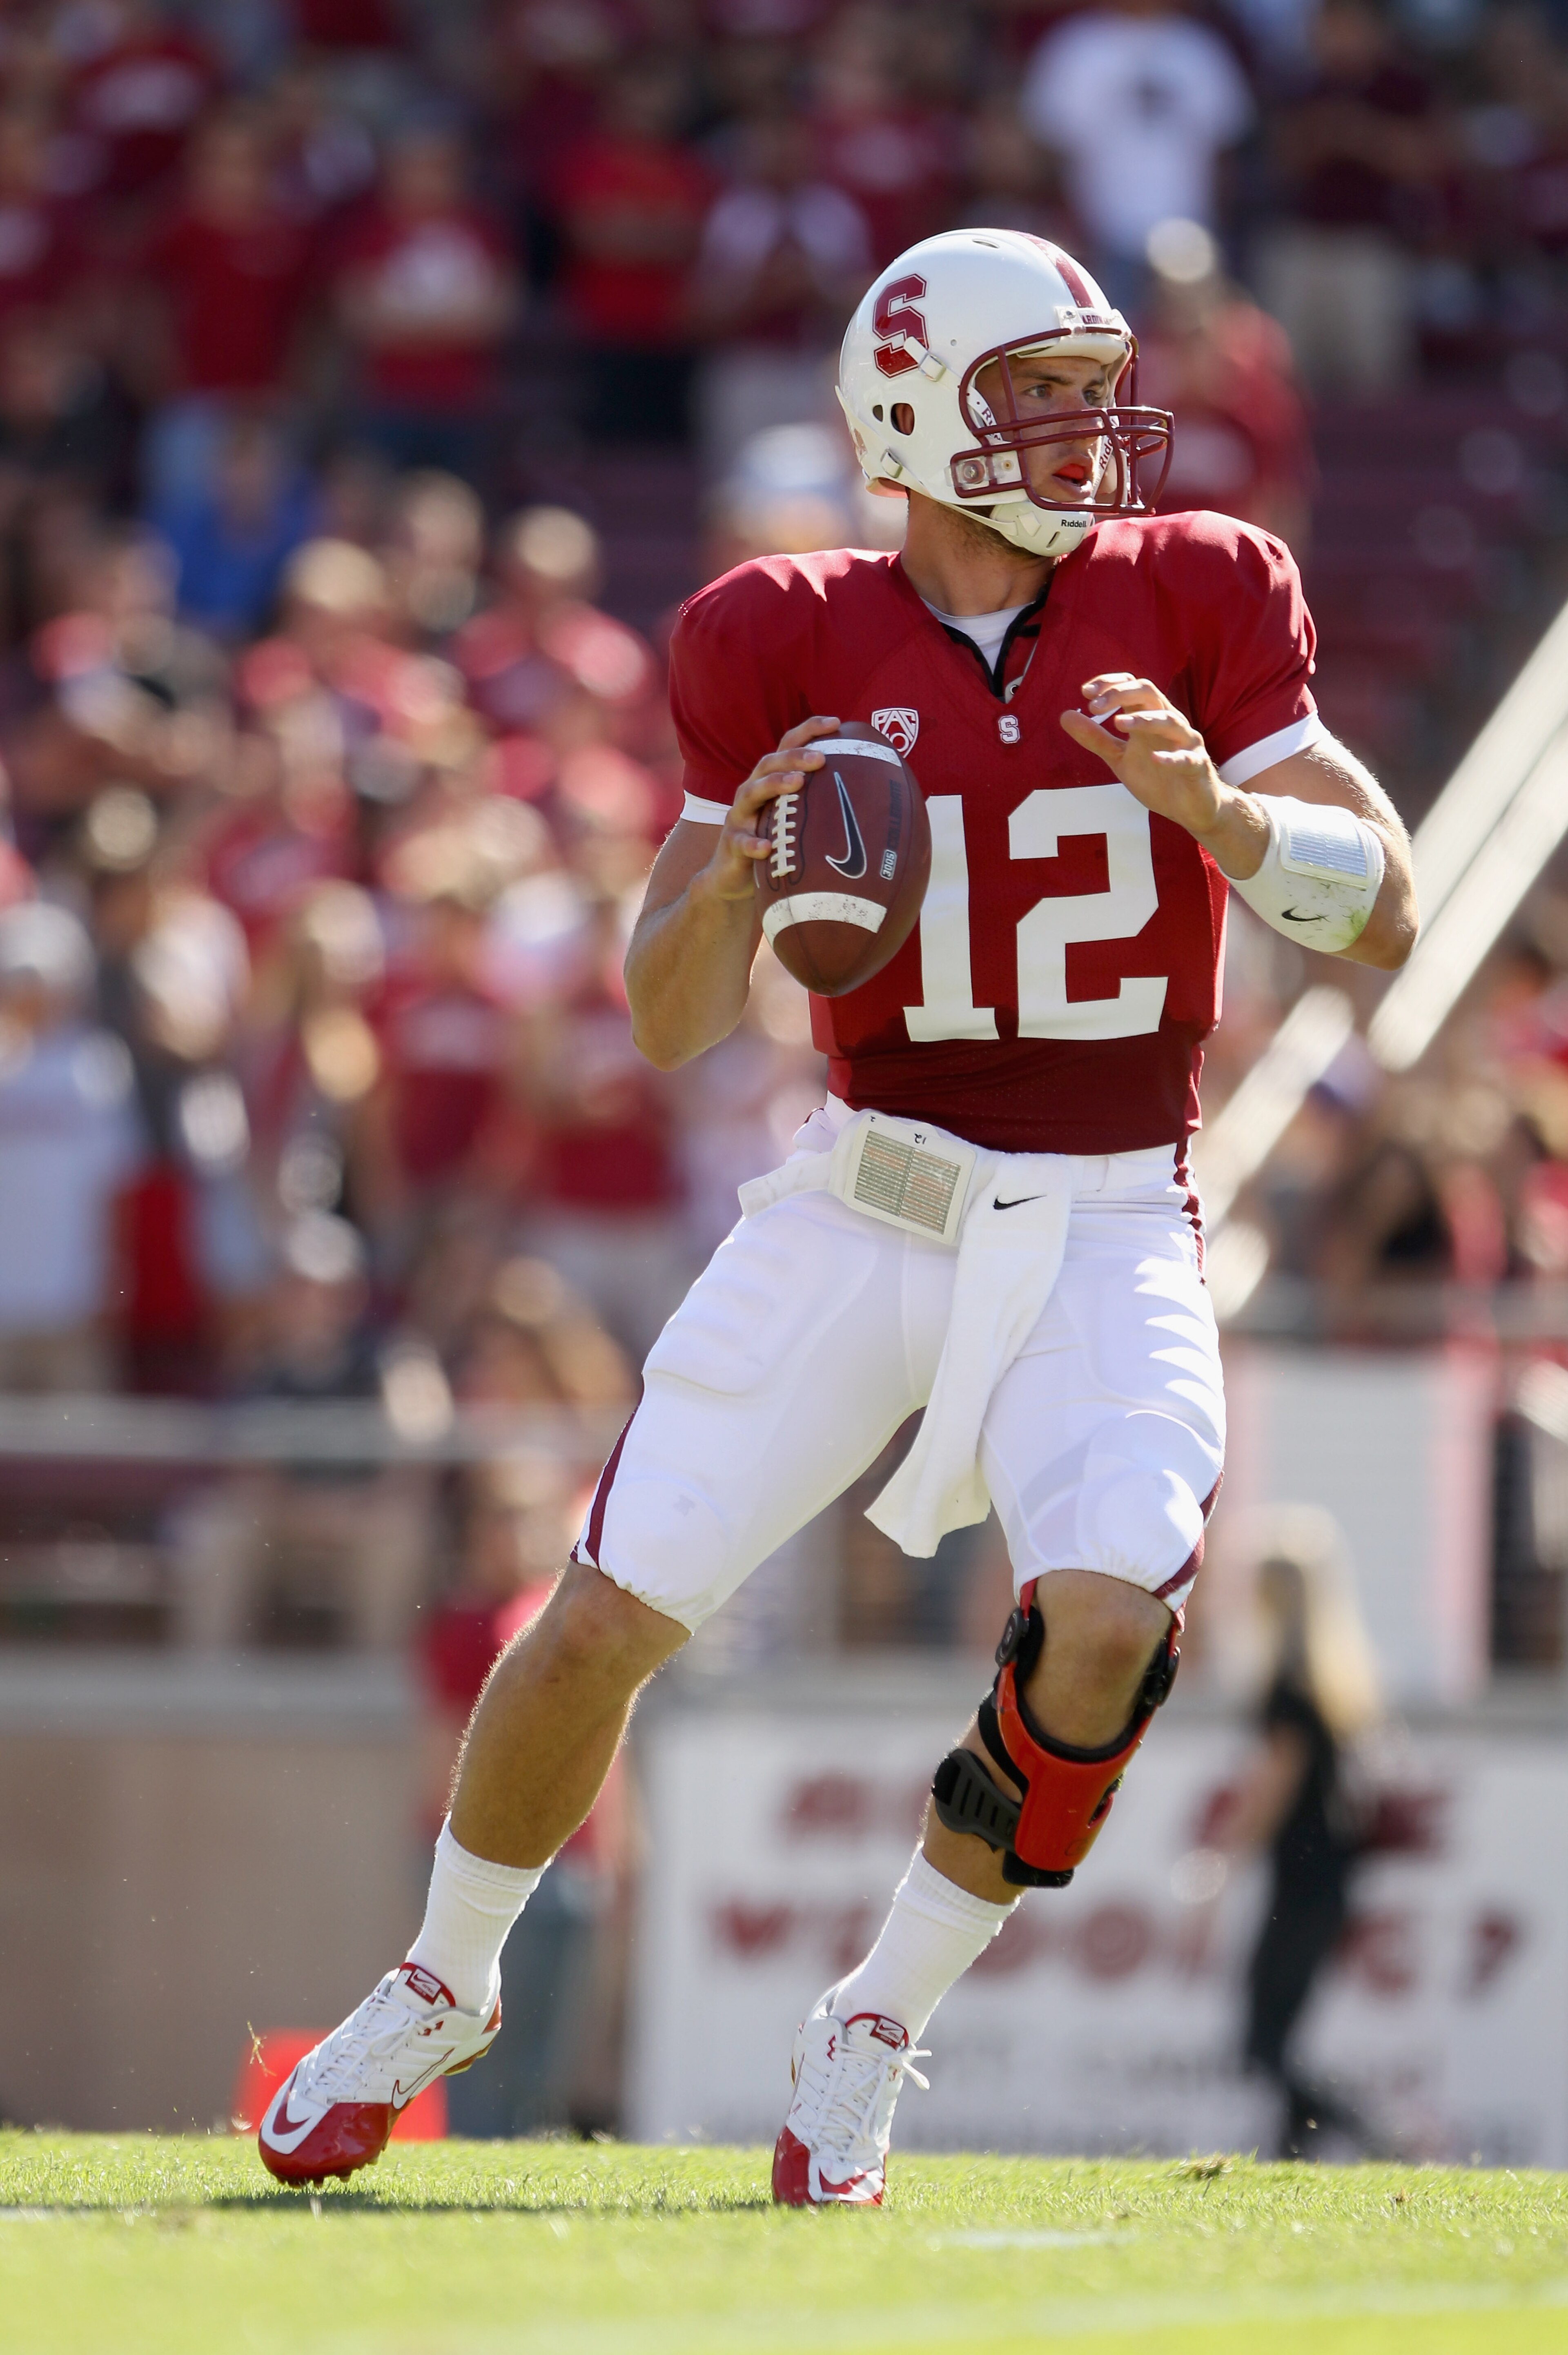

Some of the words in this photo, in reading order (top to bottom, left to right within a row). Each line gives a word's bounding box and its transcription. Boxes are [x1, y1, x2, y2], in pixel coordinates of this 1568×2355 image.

[873, 273, 929, 378] S
[1061, 519, 1087, 528] Riddell
[874, 710, 916, 742] PAC
[998, 715, 1020, 744] S
[882, 851, 895, 878] 3005
[903, 783, 1169, 1042] 12
[914, 1133, 927, 1144] 12
